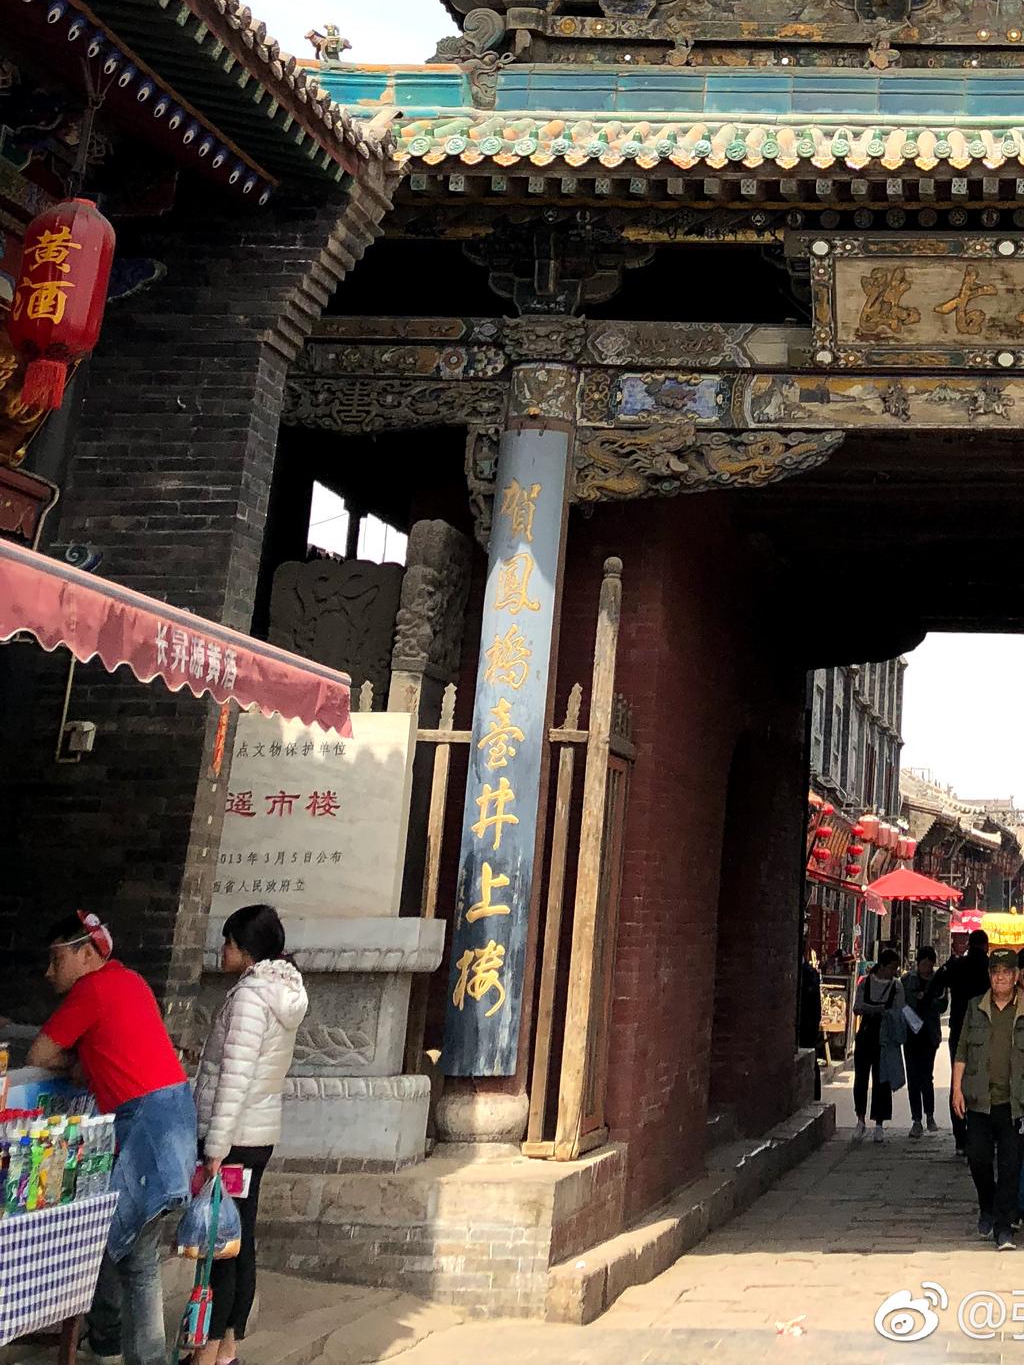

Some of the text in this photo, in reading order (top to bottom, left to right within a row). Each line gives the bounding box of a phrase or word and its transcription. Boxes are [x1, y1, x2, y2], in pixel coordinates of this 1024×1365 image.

[225, 789, 341, 818] 遥市楼
[216, 850, 343, 866] 013年3月5日公布
